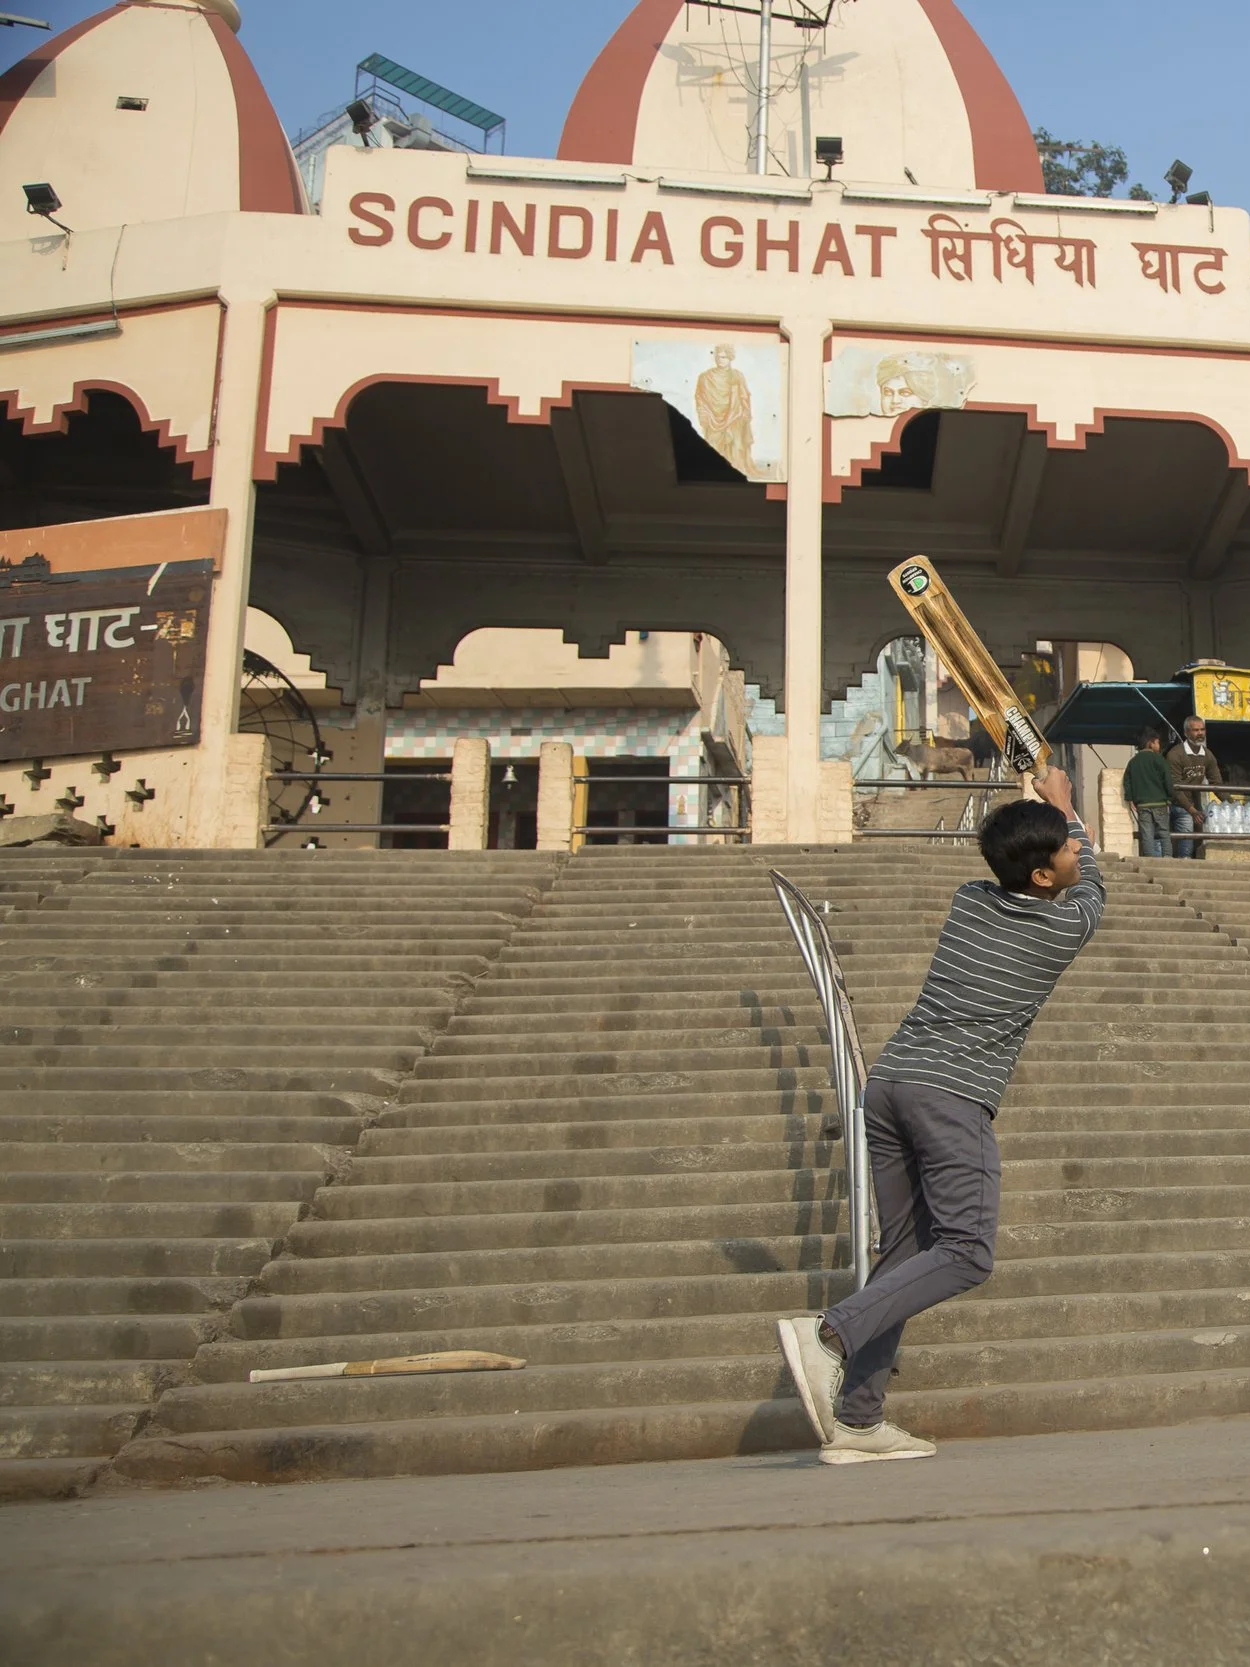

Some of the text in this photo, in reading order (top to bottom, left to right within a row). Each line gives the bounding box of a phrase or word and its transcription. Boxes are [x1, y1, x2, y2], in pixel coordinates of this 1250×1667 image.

[348, 191, 898, 278] SCINDIA GHAT
[921, 213, 1229, 295] सिंधिया घाट
[0, 676, 92, 712] GHAT
